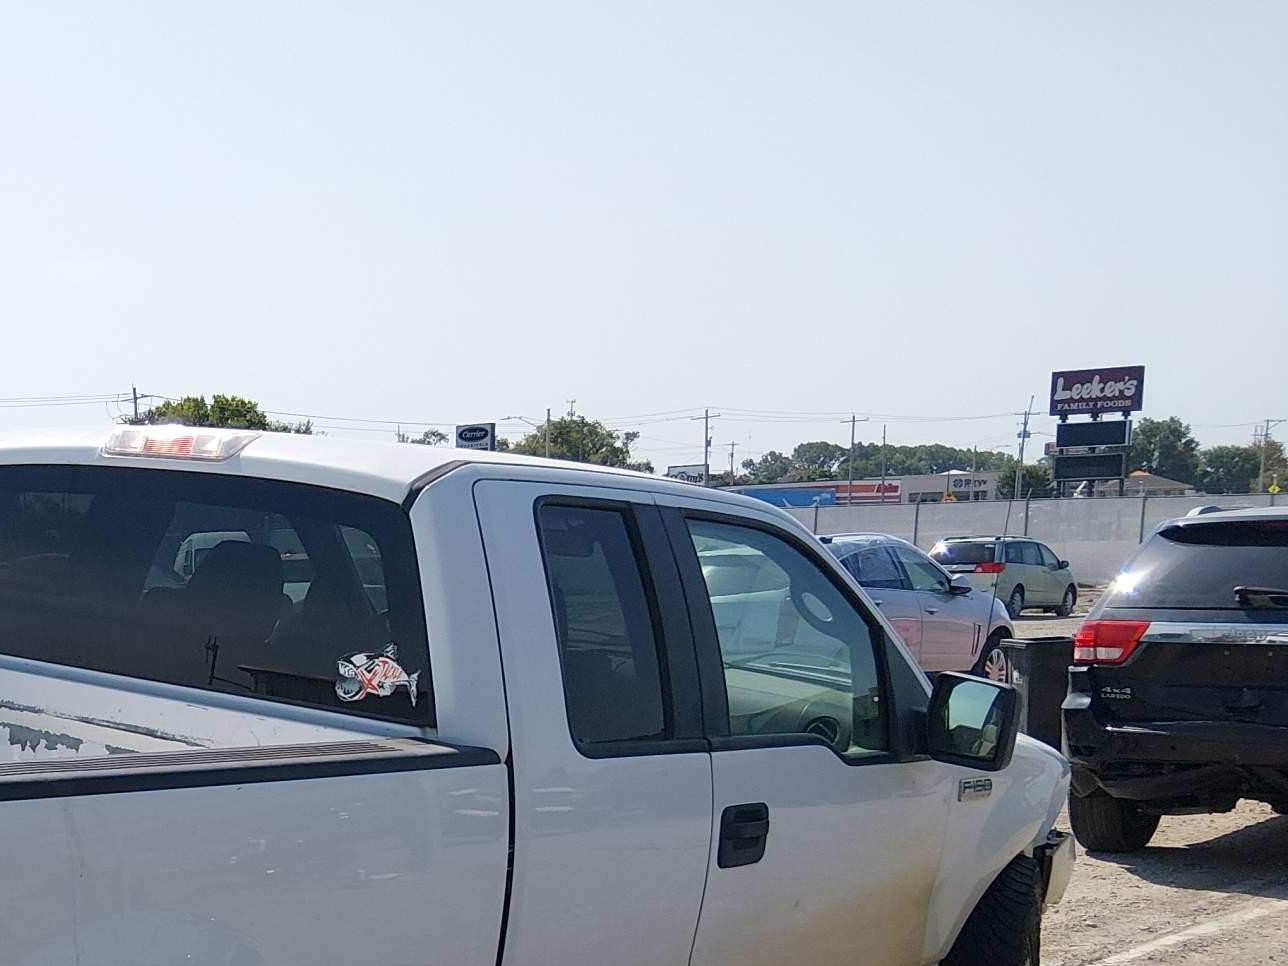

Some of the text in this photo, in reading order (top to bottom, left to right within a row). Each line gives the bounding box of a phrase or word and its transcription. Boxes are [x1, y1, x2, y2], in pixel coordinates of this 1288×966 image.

[1054, 375, 1138, 400] Leeker's
[1057, 399, 1132, 411] FAMILY FOODS
